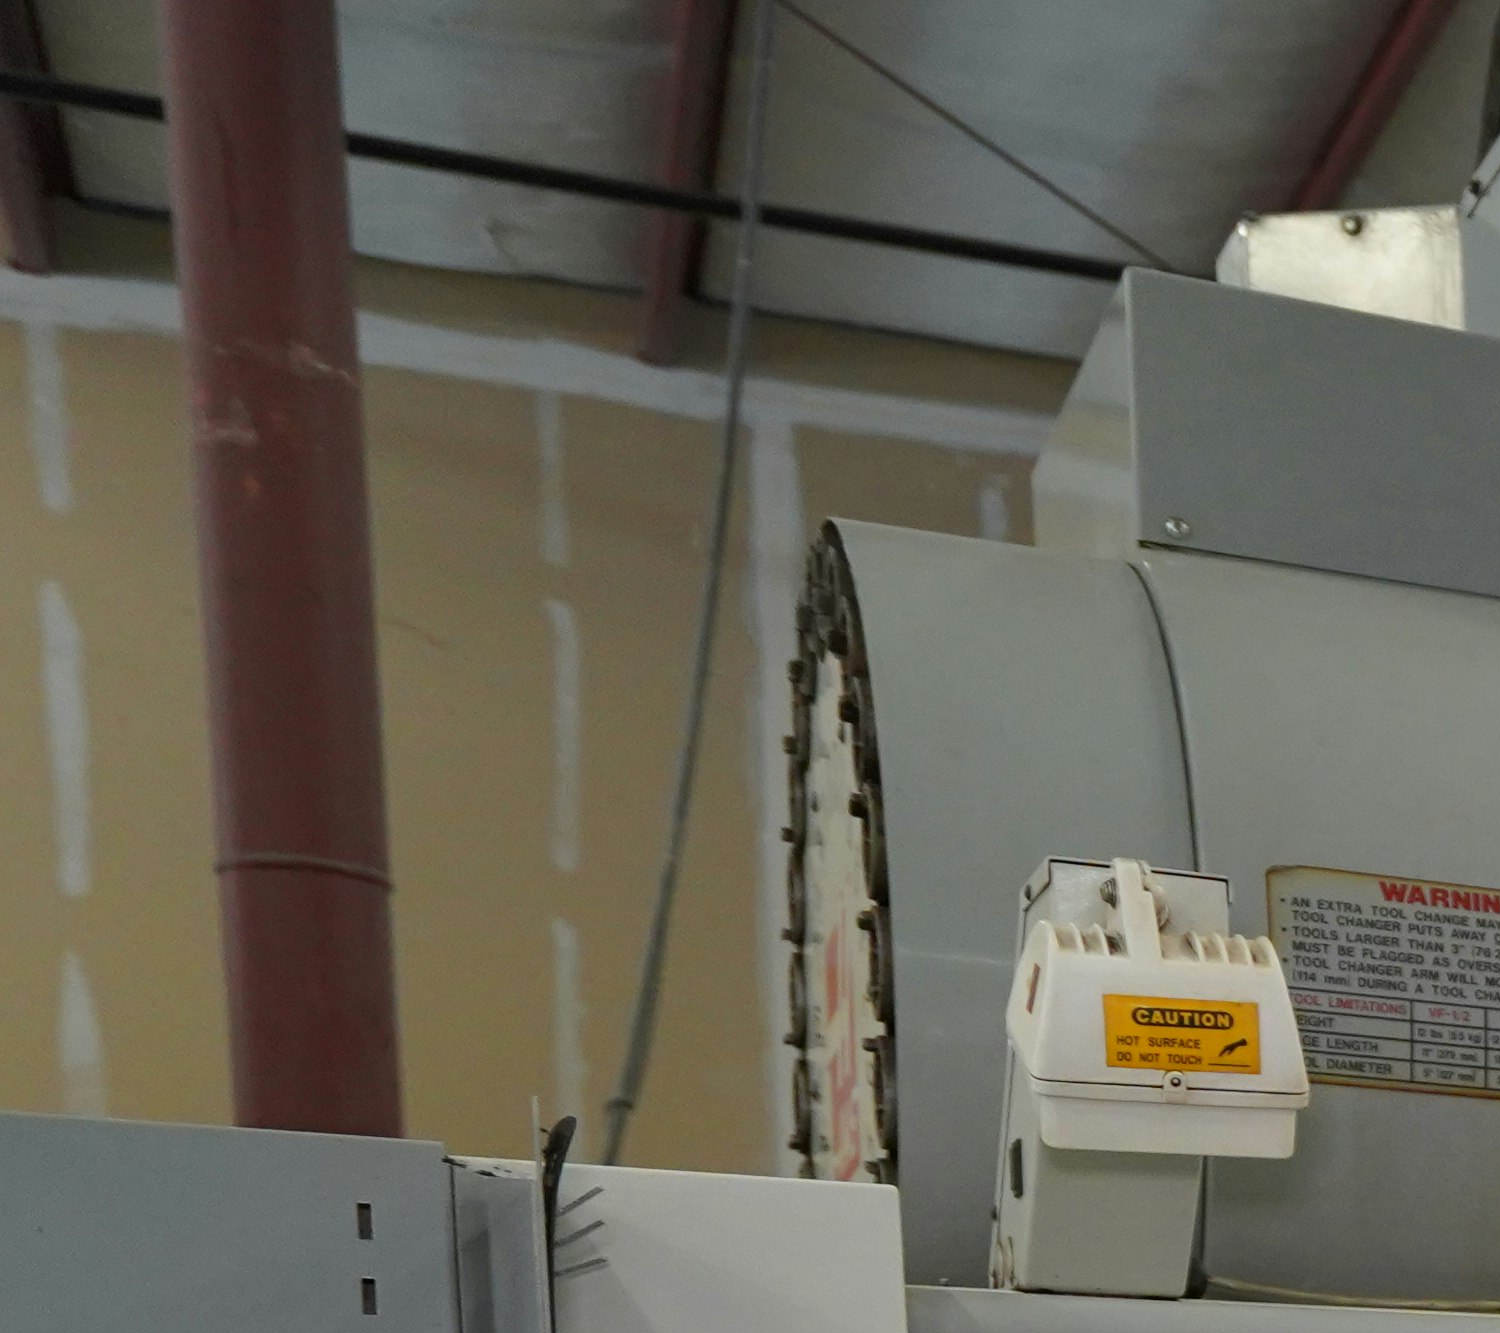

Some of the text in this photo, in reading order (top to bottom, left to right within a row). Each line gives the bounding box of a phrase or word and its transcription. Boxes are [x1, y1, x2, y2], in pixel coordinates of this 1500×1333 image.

[1291, 897, 1310, 908] AN
[1317, 899, 1362, 915] EXTRA
[1371, 905, 1407, 919] TOOL
[1414, 910, 1470, 928] CHANGE
[1292, 910, 1328, 924] TOOL
[1336, 915, 1402, 933] CHANGER
[1408, 923, 1443, 937] PUTS
[1451, 929, 1486, 941] AWAY
[1292, 926, 1338, 941] TOOLS
[1346, 933, 1399, 947] LARGER
[1407, 938, 1444, 953] THAN
[1292, 940, 1330, 954] MUST
[1338, 945, 1355, 957] BE
[1362, 949, 1424, 965] FLAGGED
[1432, 956, 1449, 968] AS
[1293, 955, 1330, 969] TOOL
[1339, 960, 1402, 976] CHANGER
[1410, 968, 1439, 981] ARM
[1447, 973, 1478, 985] WILL
[1358, 977, 1408, 992] DURING
[1415, 983, 1423, 993] A
[1432, 985, 1468, 1000] TOOL
[1328, 997, 1406, 1015] LIMITATIONS
[1135, 1009, 1230, 1028] CAUTION
[1116, 1035, 1201, 1049] HOT SURFACE
[1326, 1037, 1378, 1052] LENGTH
[1116, 1051, 1202, 1065] DO NOT TOUCH
[1326, 1058, 1392, 1074] DIAMETER
